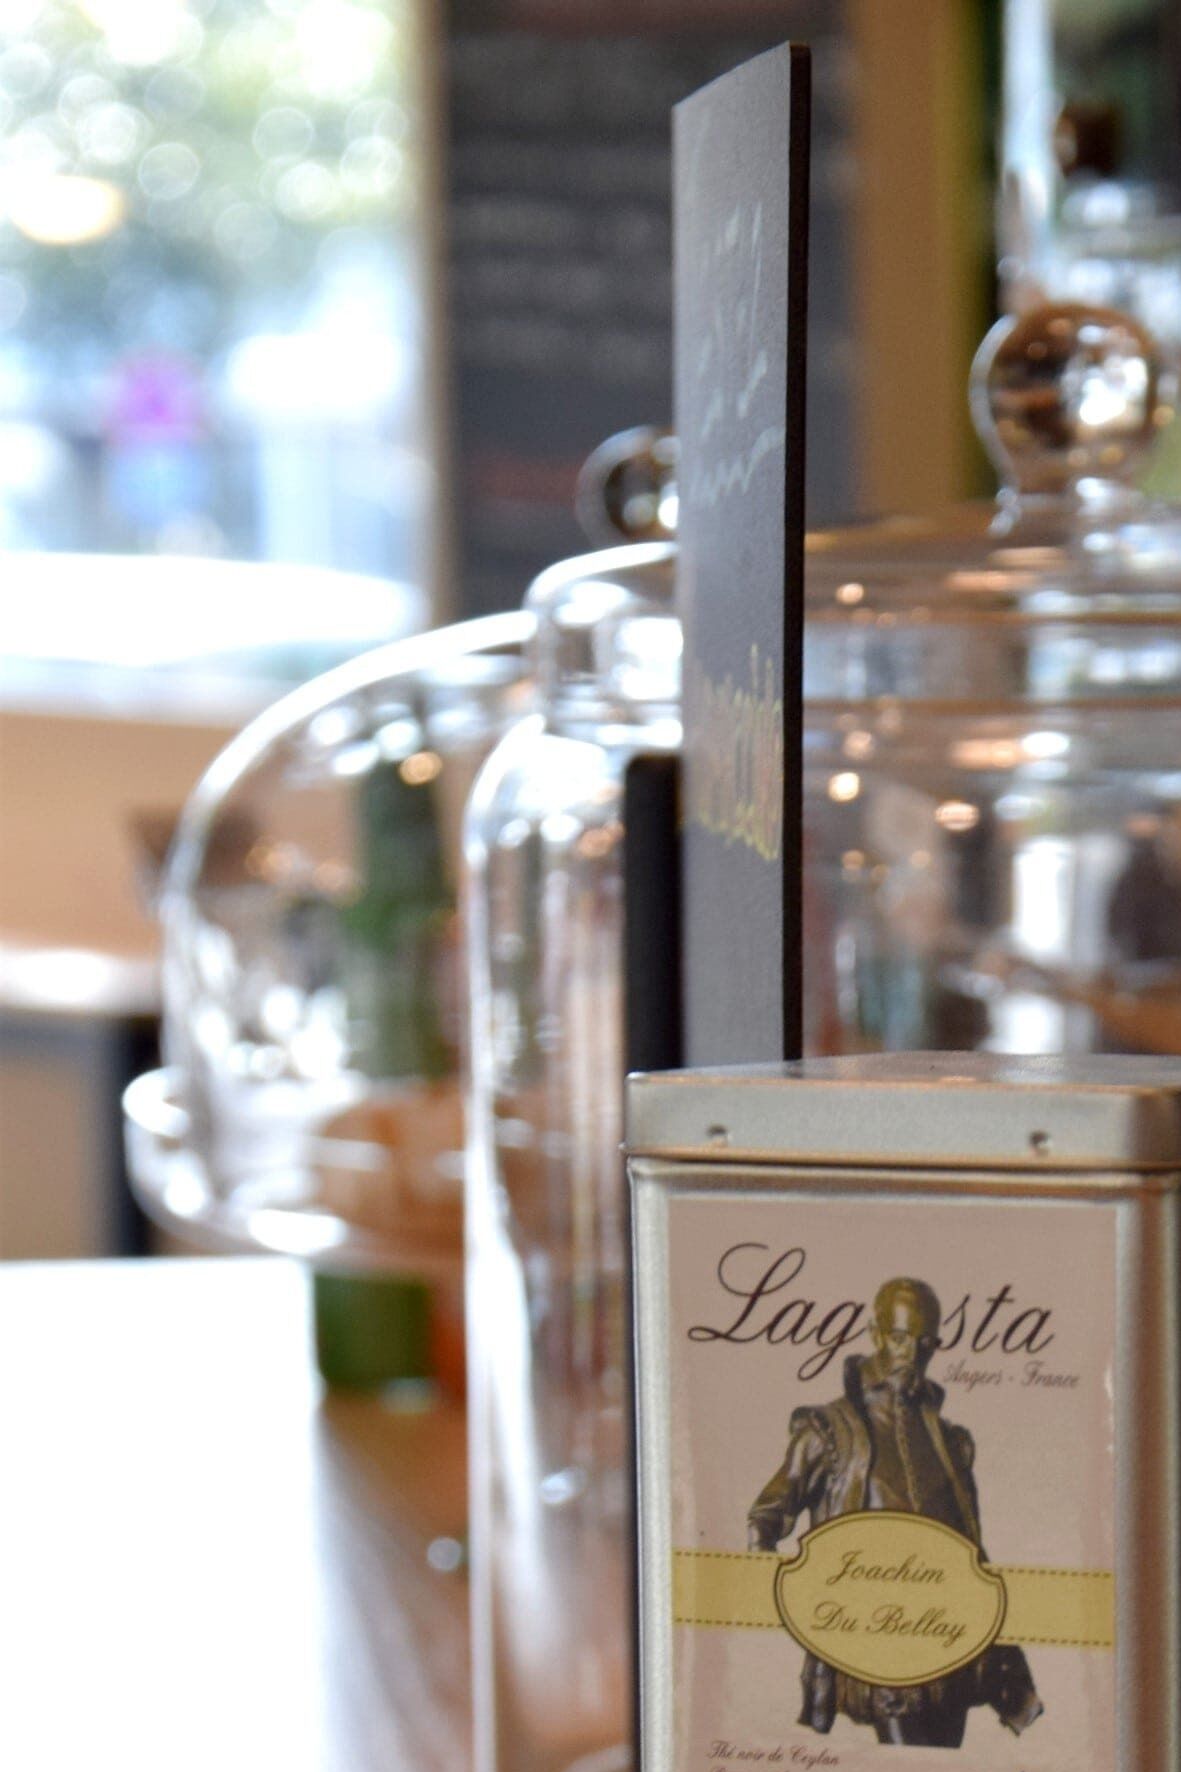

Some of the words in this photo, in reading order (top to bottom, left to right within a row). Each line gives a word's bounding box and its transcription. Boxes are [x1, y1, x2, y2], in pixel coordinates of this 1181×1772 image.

[943, 1360, 1002, 1392] Angers
[1020, 1358, 1080, 1388] France
[826, 1550, 946, 1586] Joachim
[810, 1600, 858, 1633] Du
[865, 1603, 967, 1649] Bellay
[767, 1745, 783, 1761] de
